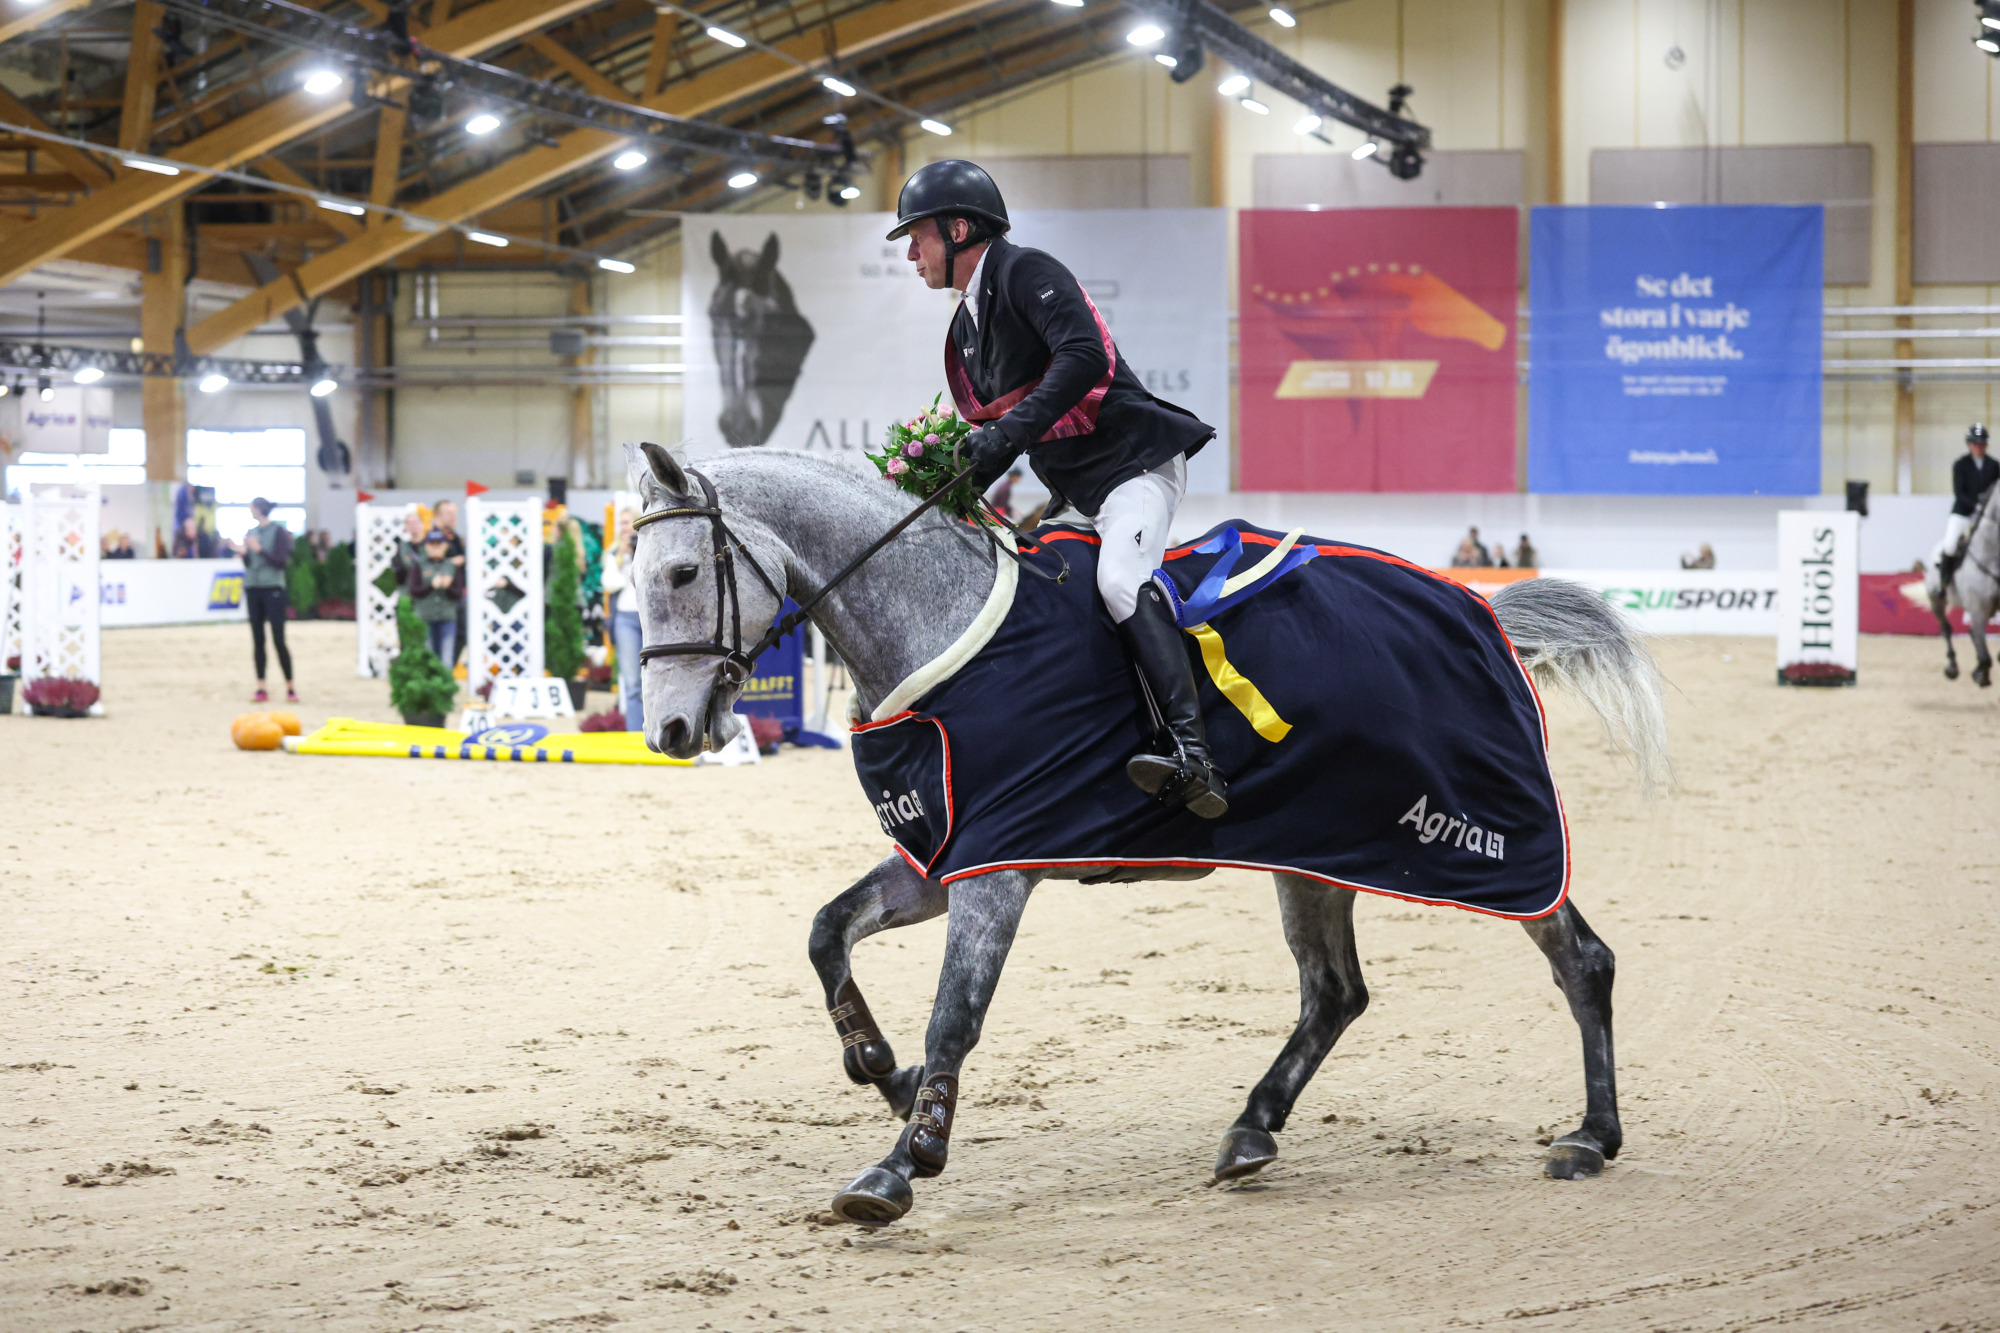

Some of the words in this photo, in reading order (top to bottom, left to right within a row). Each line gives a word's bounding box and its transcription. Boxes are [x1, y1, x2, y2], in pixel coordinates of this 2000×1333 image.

[1041, 289, 1054, 299] BOSS
[1636, 274, 1668, 298] Se
[1670, 272, 1713, 298] det
[1600, 306, 1666, 328] stora
[1671, 302, 1680, 328] i
[1683, 302, 1749, 333] varje
[1605, 335, 1744, 365] ögonblick.
[1602, 588, 1778, 611] EQUISPORT
[1802, 526, 1835, 650] Hööks
[875, 789, 920, 837] gria
[1398, 794, 1482, 854] Agria
